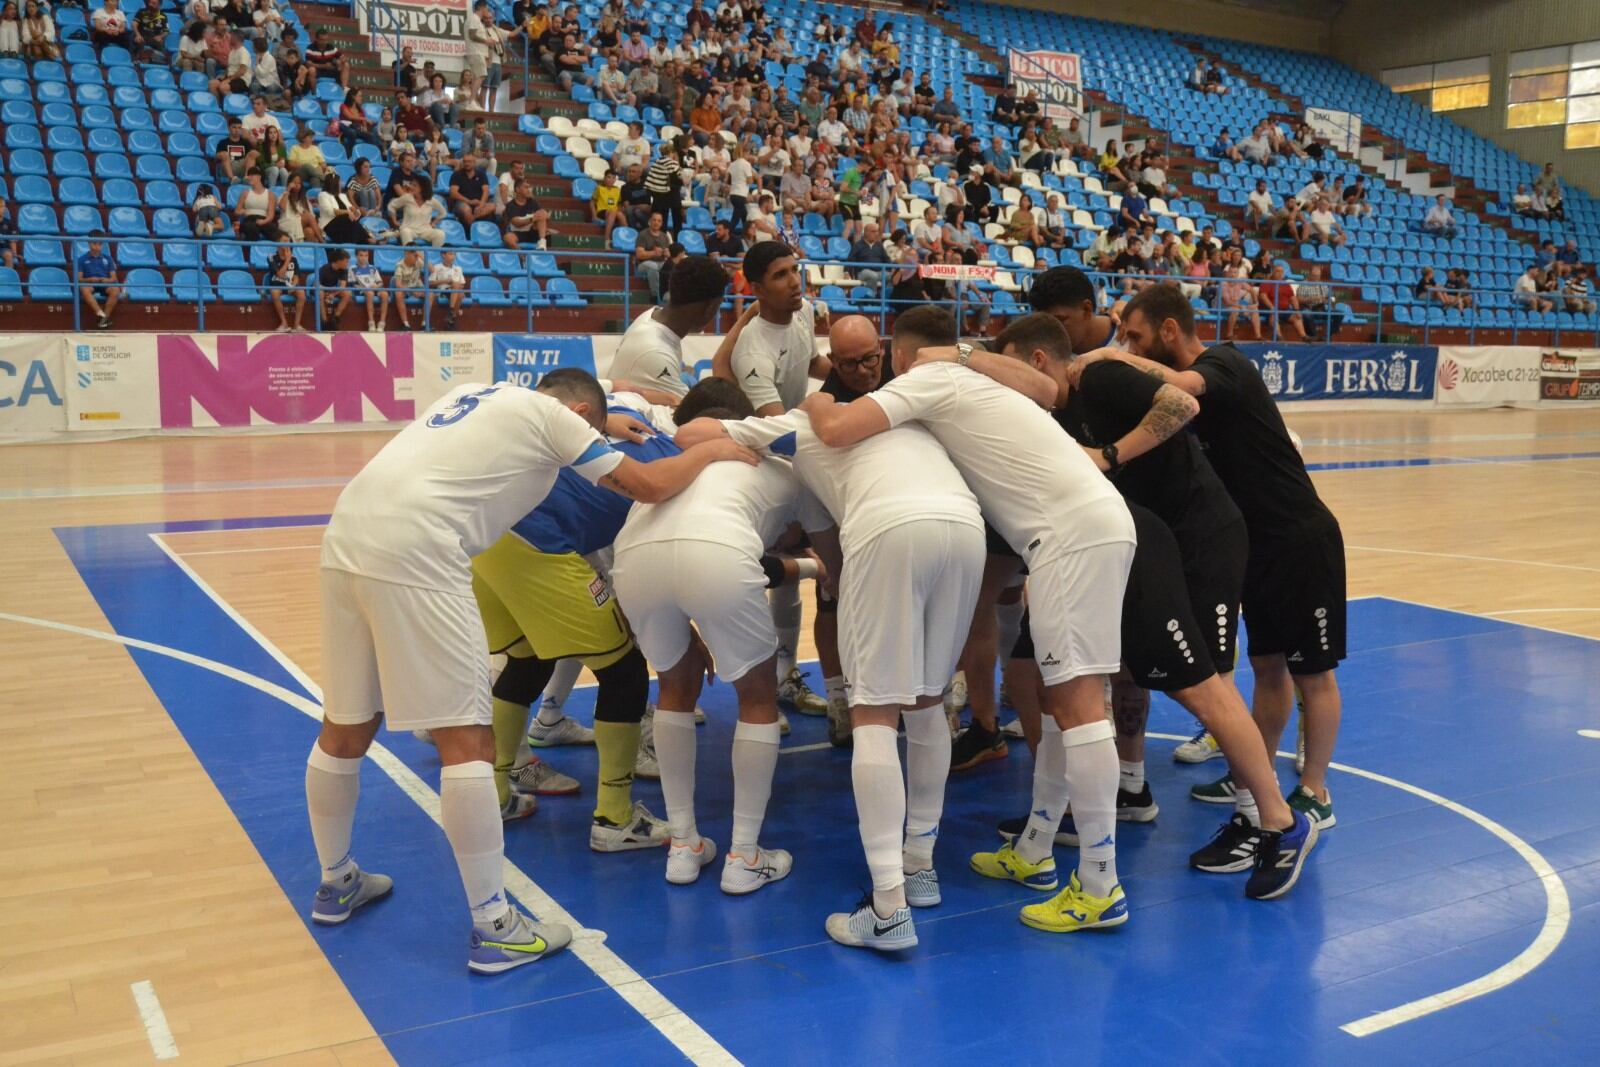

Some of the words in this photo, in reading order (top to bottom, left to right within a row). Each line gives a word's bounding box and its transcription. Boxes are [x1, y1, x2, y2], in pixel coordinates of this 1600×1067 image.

[505, 348, 538, 366] SIN
[542, 349, 561, 366] TI
[506, 371, 533, 387] NO
